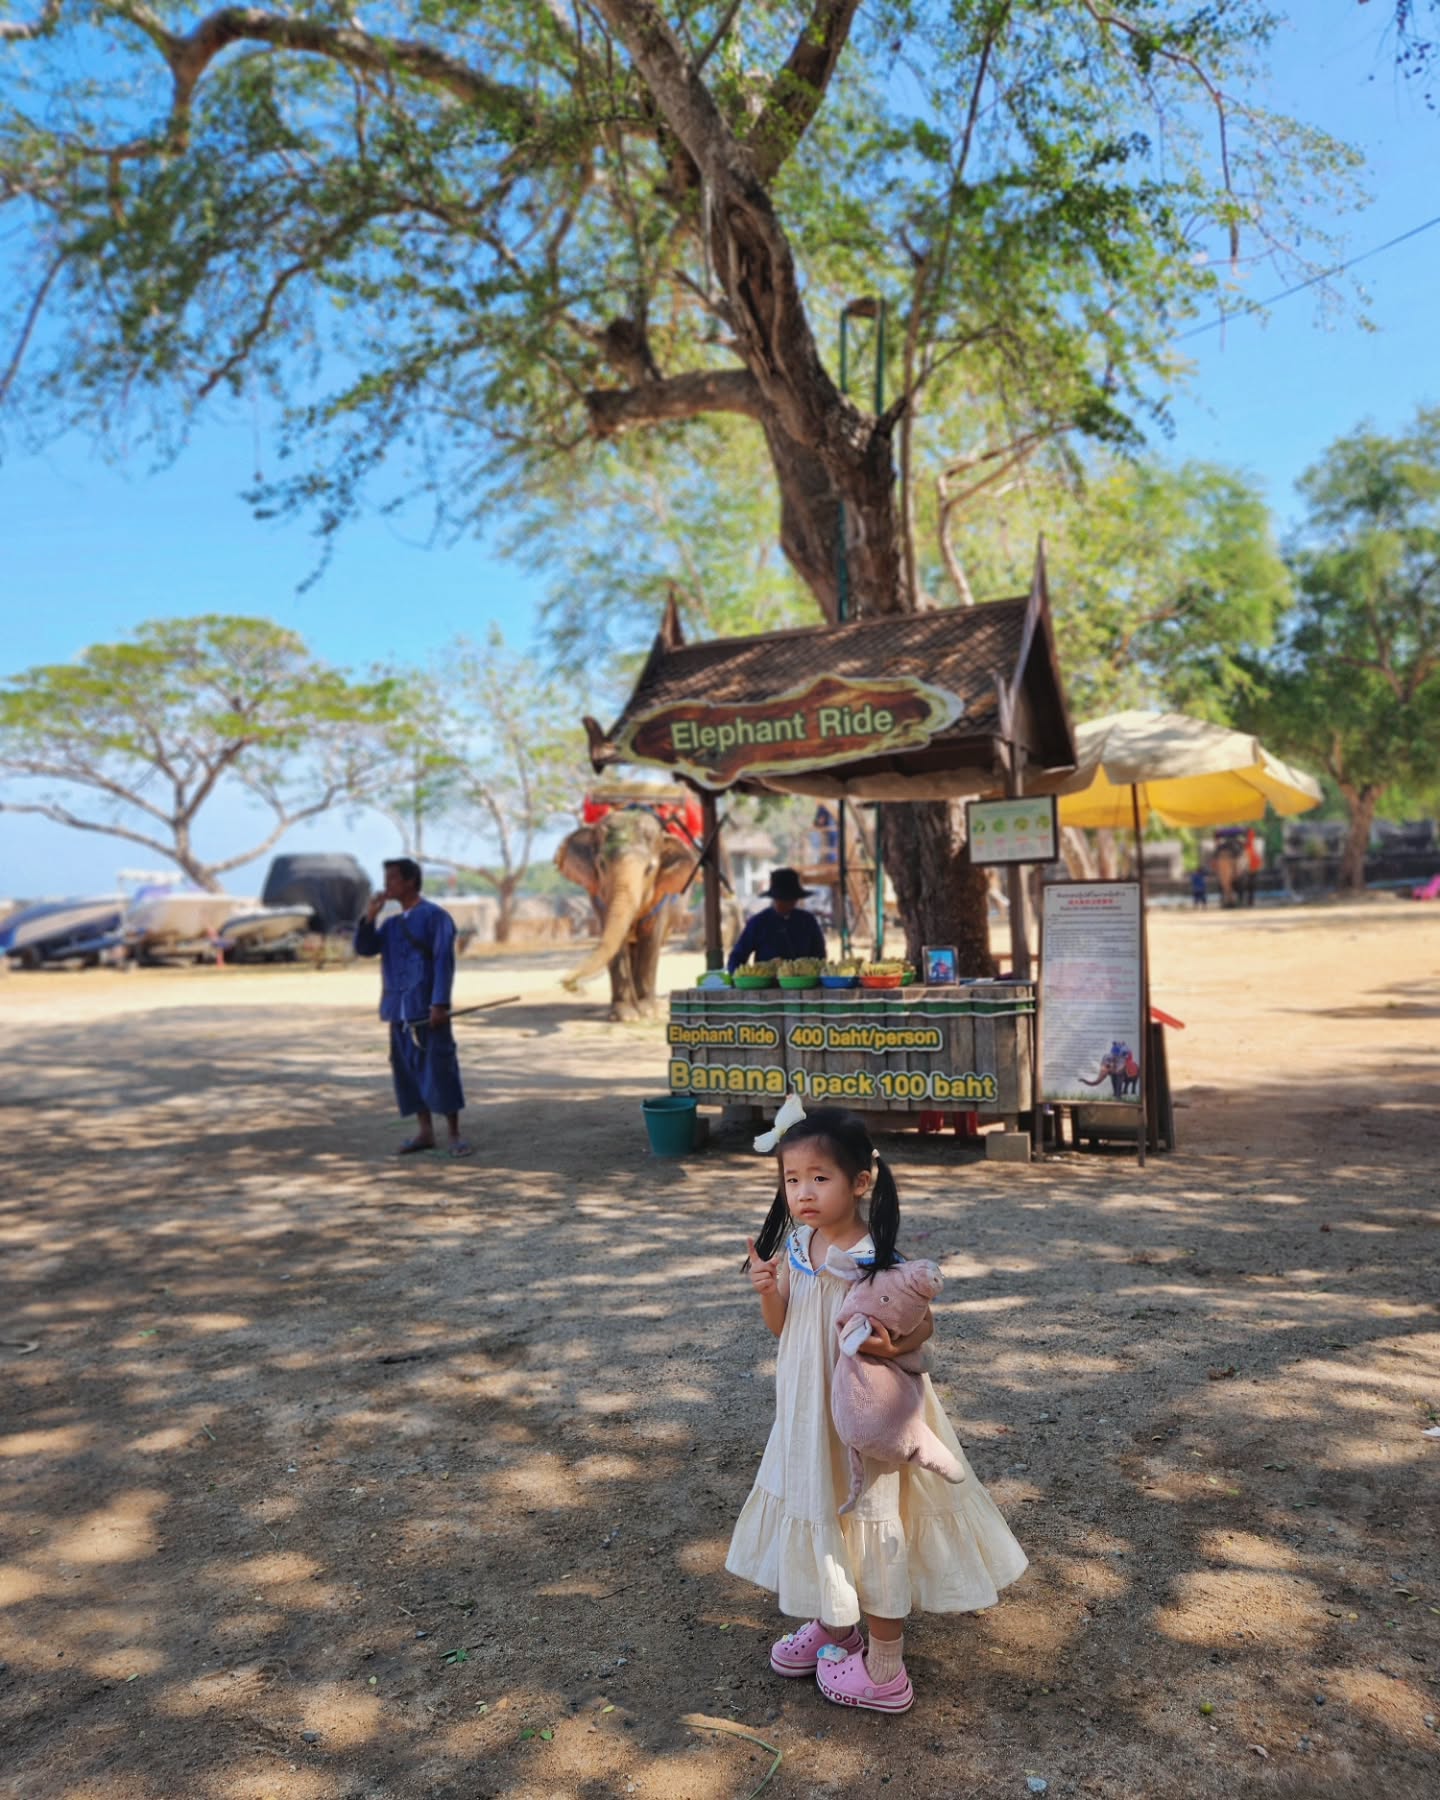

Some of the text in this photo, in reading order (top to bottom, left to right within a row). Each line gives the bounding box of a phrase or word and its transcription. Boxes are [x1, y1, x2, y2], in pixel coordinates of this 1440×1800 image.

[670, 705, 894, 752] Elephant Ride
[668, 1025, 938, 1049] Elephant Ride 400 baht/person
[671, 1061, 994, 1098] Banana 1 pack 100 baht
[823, 1685, 858, 1705] crocs
